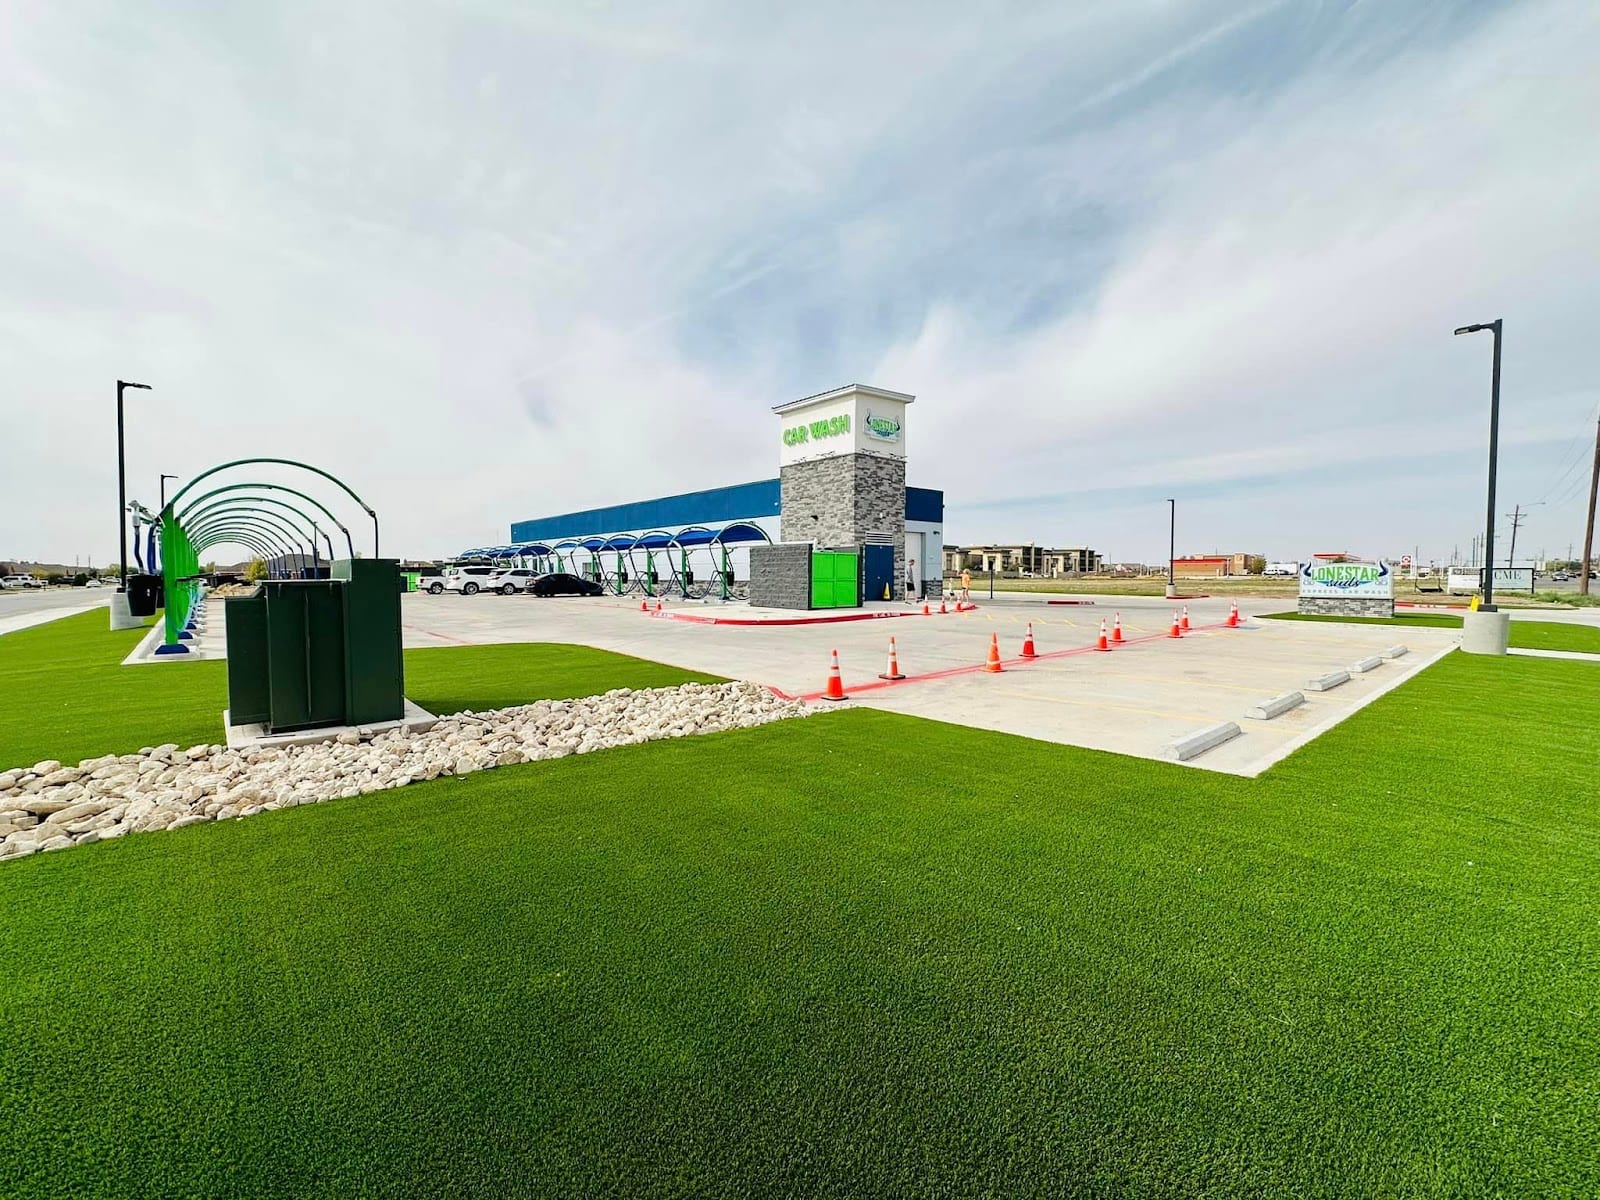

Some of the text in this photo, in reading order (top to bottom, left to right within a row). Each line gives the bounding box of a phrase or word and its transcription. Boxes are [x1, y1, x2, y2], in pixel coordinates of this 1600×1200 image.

[783, 414, 851, 446] CAR WASH
[1311, 566, 1379, 581] LONESTAR
[1494, 570, 1522, 580] CME
